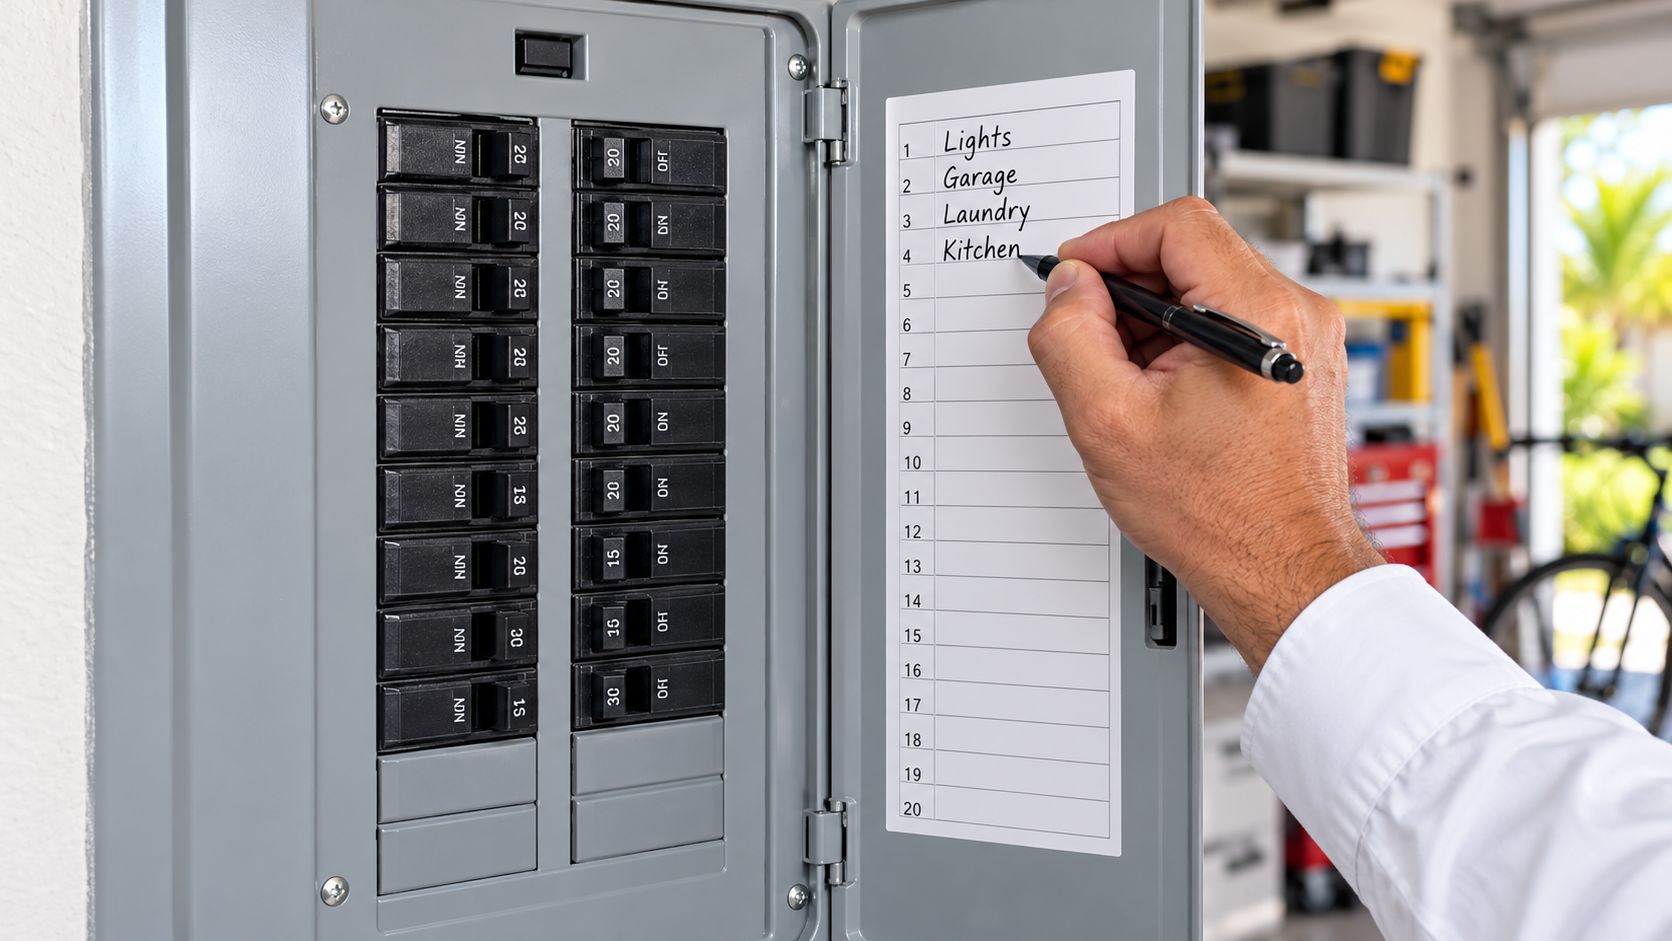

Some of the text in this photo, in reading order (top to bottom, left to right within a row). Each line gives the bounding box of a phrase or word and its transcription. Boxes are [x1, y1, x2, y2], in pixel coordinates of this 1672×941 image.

[945, 125, 1010, 160] Lights
[607, 148, 620, 167] 20
[903, 143, 909, 158] 1
[902, 178, 911, 194] 2
[944, 166, 1017, 195] Garage
[902, 214, 911, 229] 3
[944, 197, 1030, 231] Laundry
[607, 213, 620, 232] 20
[902, 248, 912, 263] 4
[944, 236, 1021, 261] Kitchen
[903, 283, 911, 298] 5
[902, 317, 912, 333] 6
[607, 347, 620, 365] 20
[902, 352, 911, 367] 7
[902, 386, 912, 401] 8
[606, 414, 620, 432] 20
[657, 412, 669, 432] ON
[902, 421, 911, 436] 9
[904, 455, 922, 470] 10
[904, 490, 920, 505] 11
[904, 524, 921, 539] 12
[606, 549, 620, 568] 15
[904, 559, 922, 574] 13
[904, 593, 921, 608] 14
[904, 628, 922, 643] 15
[904, 663, 922, 678] 16
[904, 697, 921, 712] 17
[905, 732, 922, 747] 18
[904, 767, 922, 782] 19
[903, 801, 922, 817] 20
